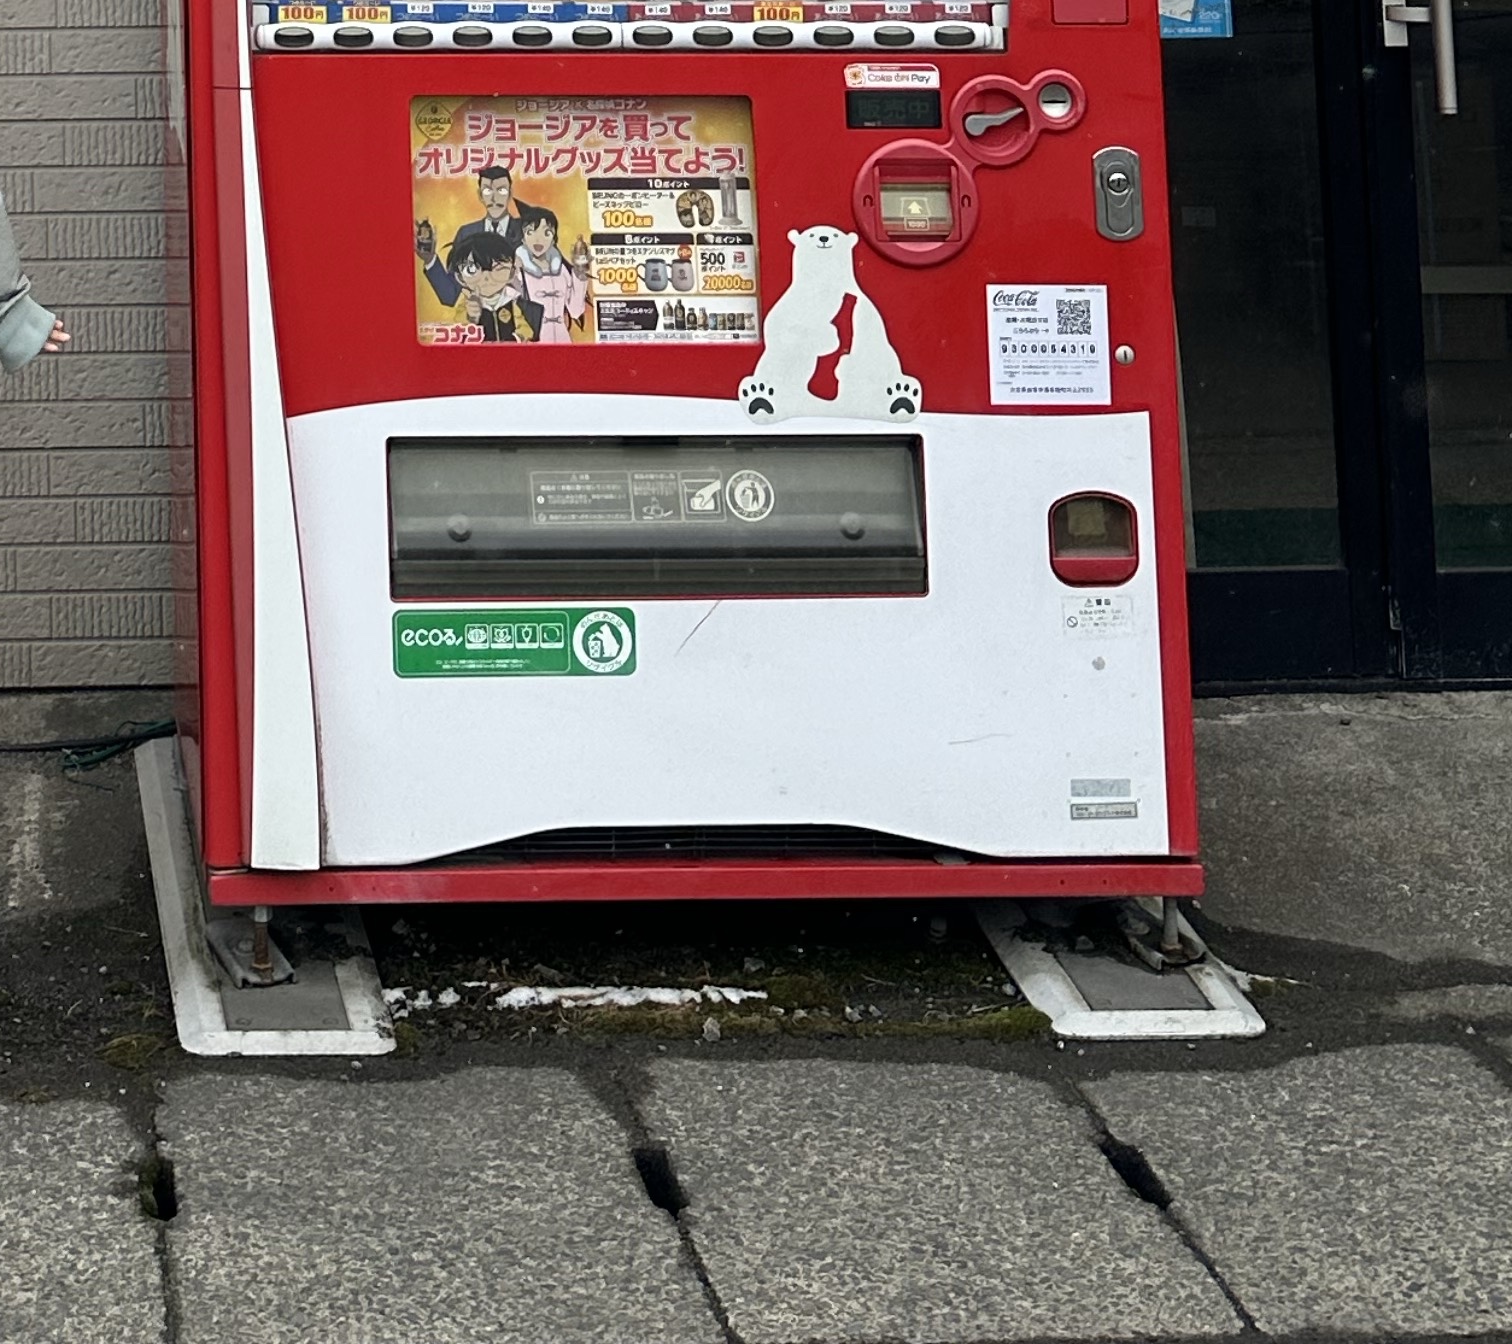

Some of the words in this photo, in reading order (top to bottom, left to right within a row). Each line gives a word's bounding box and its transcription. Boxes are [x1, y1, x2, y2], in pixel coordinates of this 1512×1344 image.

[281, 7, 324, 20] 100円
[345, 7, 388, 20] 100円
[758, 7, 800, 21] 100円
[867, 73, 893, 83] Coke
[911, 73, 931, 84] Pay
[467, 112, 694, 143] ジョージアを買って
[417, 146, 745, 175] オリジナルグッズ当てよう!
[700, 252, 726, 265] 500
[598, 268, 638, 285] 1000
